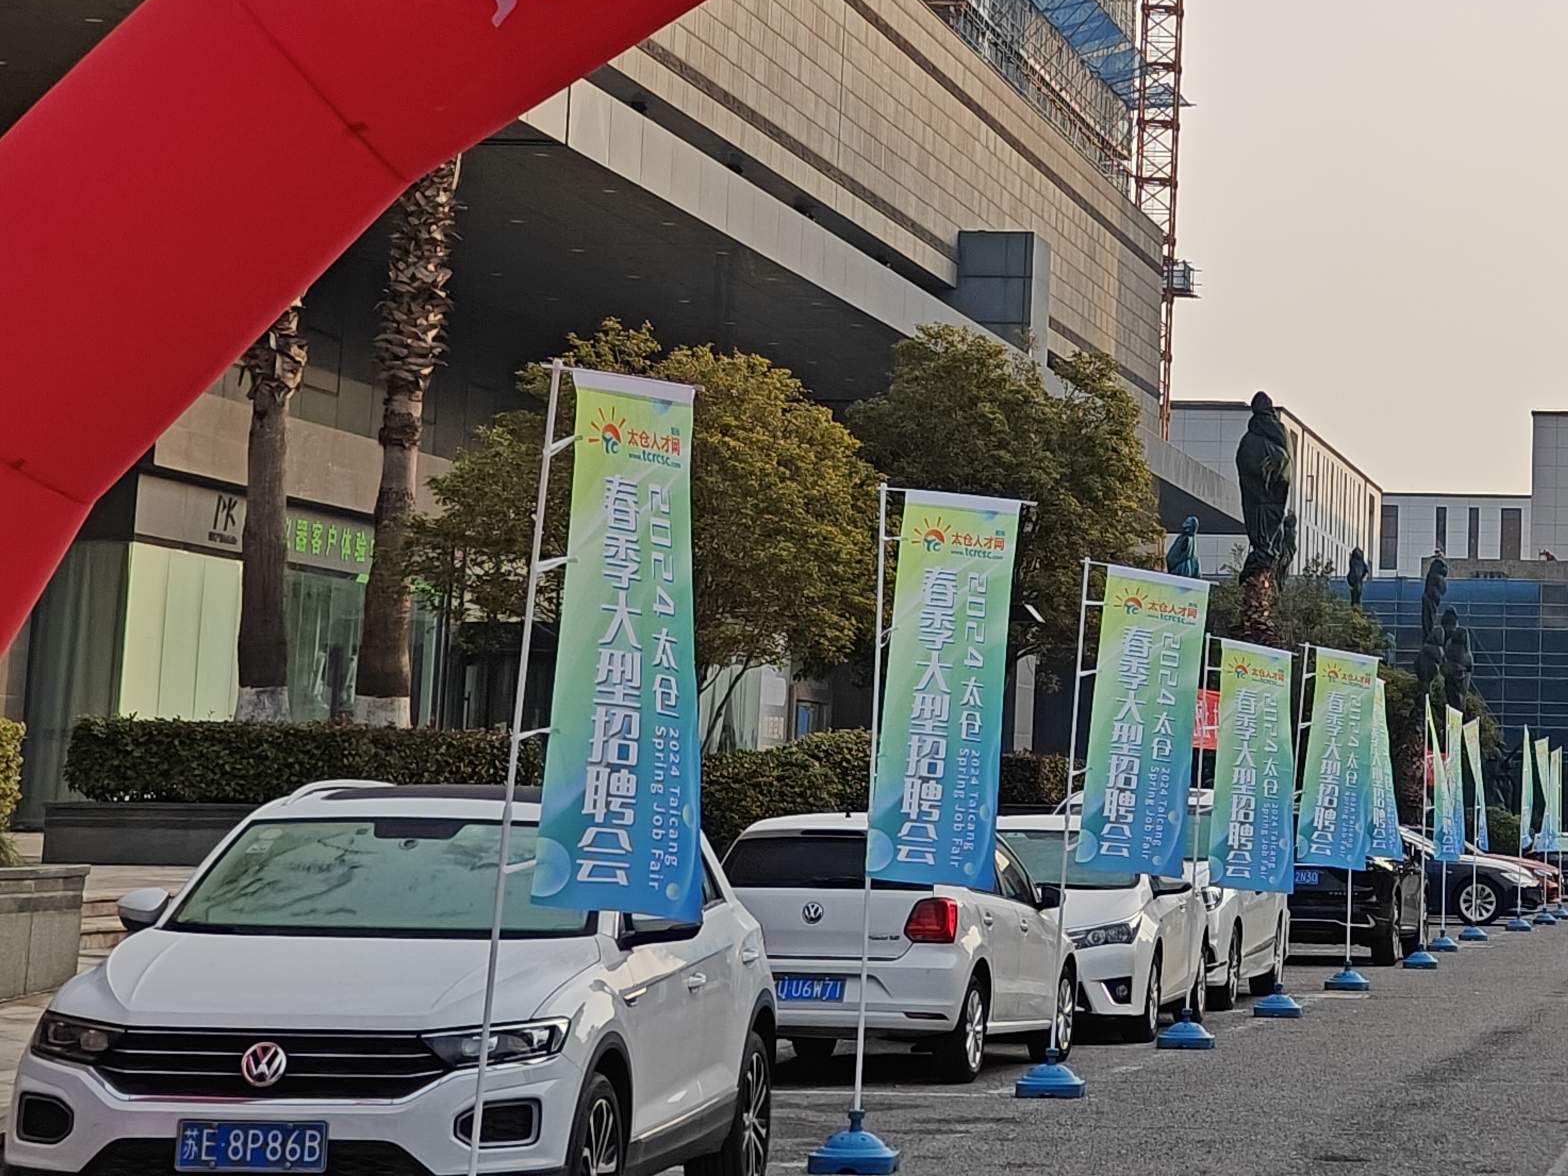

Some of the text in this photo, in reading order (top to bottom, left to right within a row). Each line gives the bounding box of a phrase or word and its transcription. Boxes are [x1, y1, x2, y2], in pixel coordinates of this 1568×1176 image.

[627, 428, 681, 456] 太仓人才网
[287, 517, 375, 563] 器客户体验
[951, 532, 1005, 551] 太仓人才网
[1148, 601, 1198, 619] 太仓人才网
[576, 475, 642, 886] 春季大型招聘会
[896, 567, 957, 865] 春季大型招聘会
[1099, 626, 1153, 858] 春季大型招聘会
[648, 726, 667, 891] Spring Job Fair
[664, 728, 681, 867] 2024 Taicang
[949, 748, 970, 868] Spring Job Fair
[963, 749, 980, 851] 2024 Taicang
[1225, 688, 1258, 879] 春季大型招聘会
[1310, 692, 1344, 856] 春季大型招聘会
